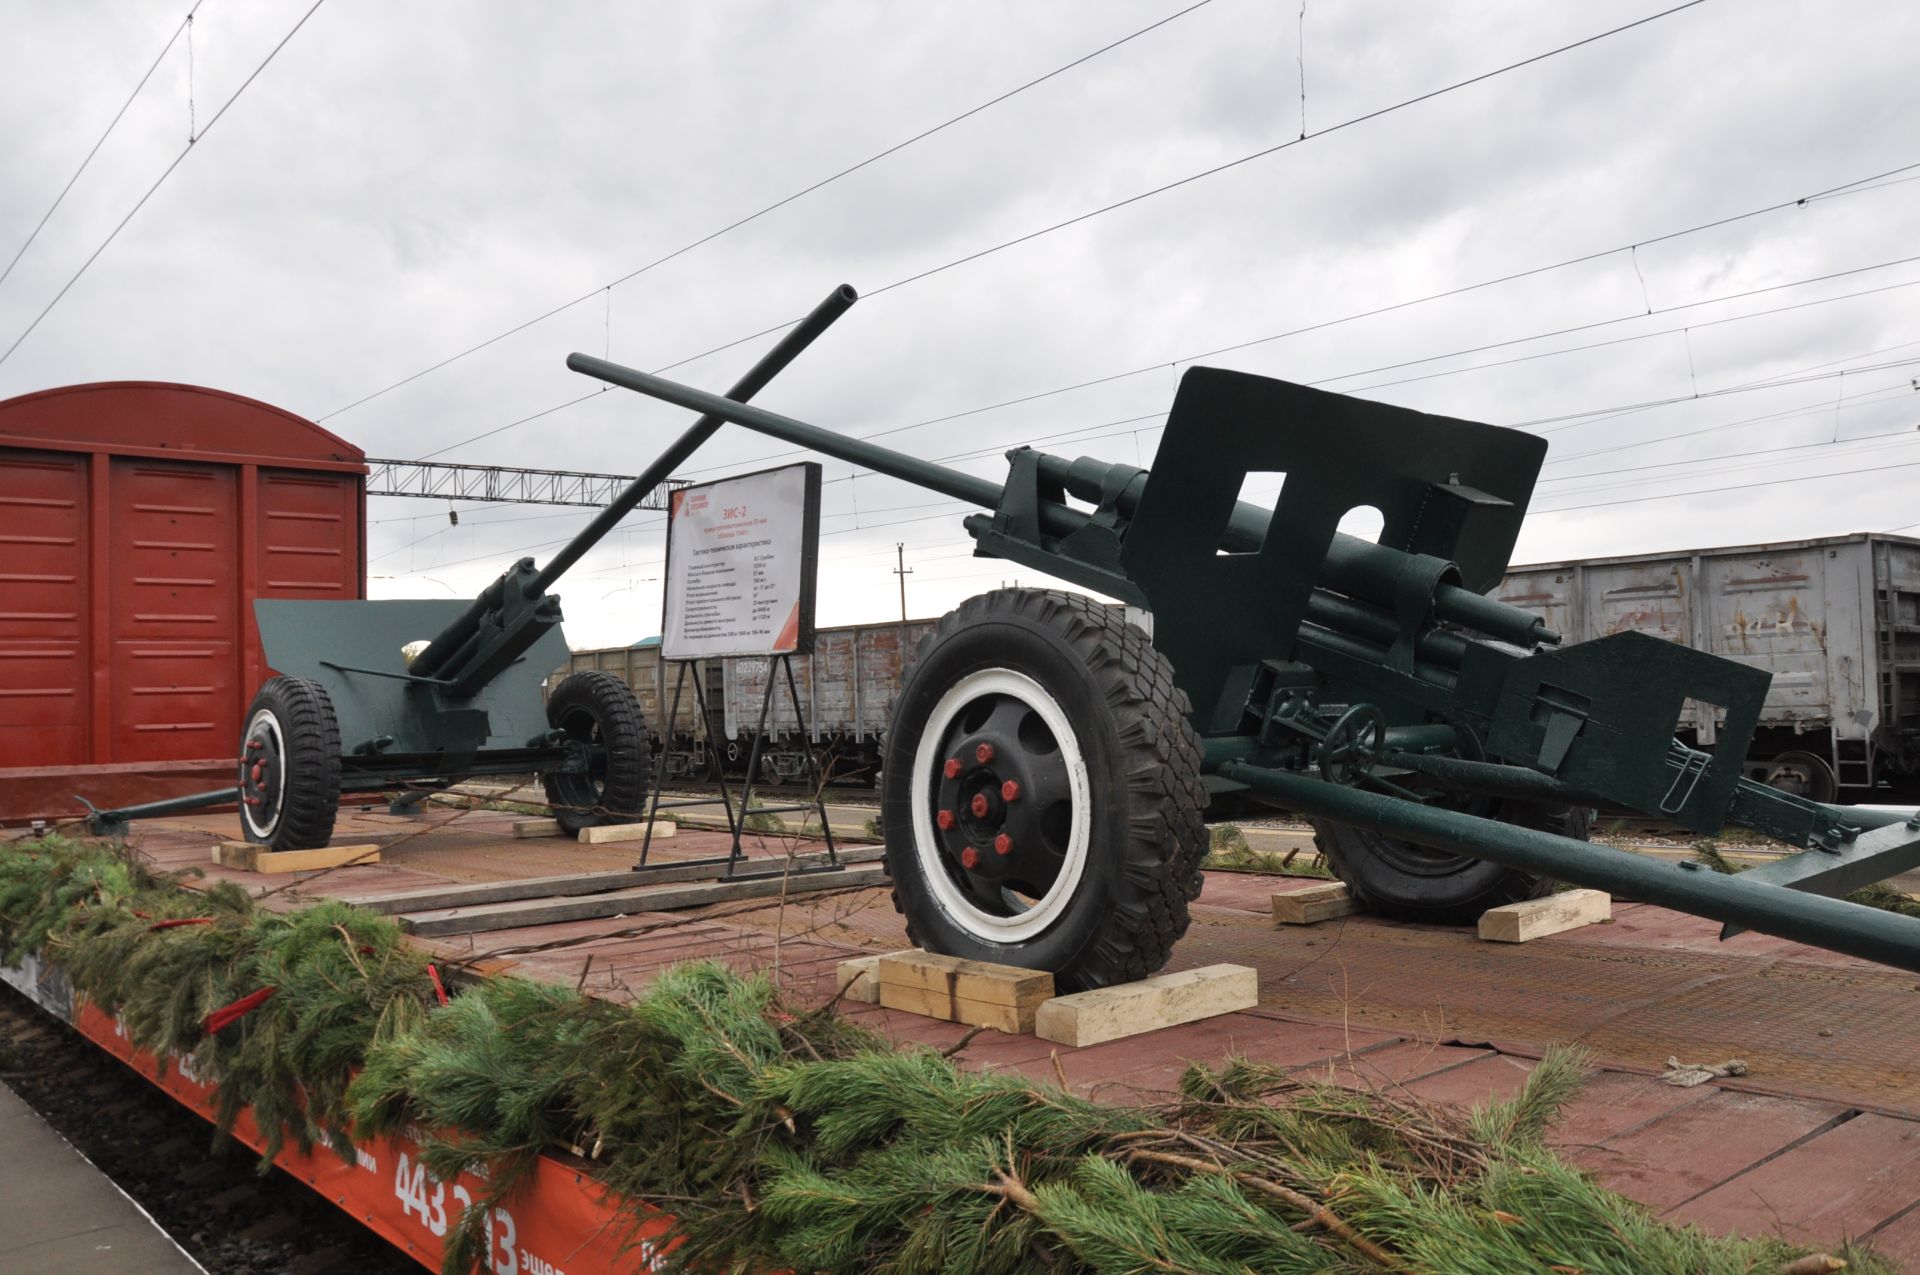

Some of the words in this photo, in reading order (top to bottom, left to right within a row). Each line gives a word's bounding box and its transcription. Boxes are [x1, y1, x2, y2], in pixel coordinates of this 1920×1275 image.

[722, 505, 747, 520] ЗИС-2
[735, 662, 768, 673] 60229754
[395, 1152, 447, 1237] 443
